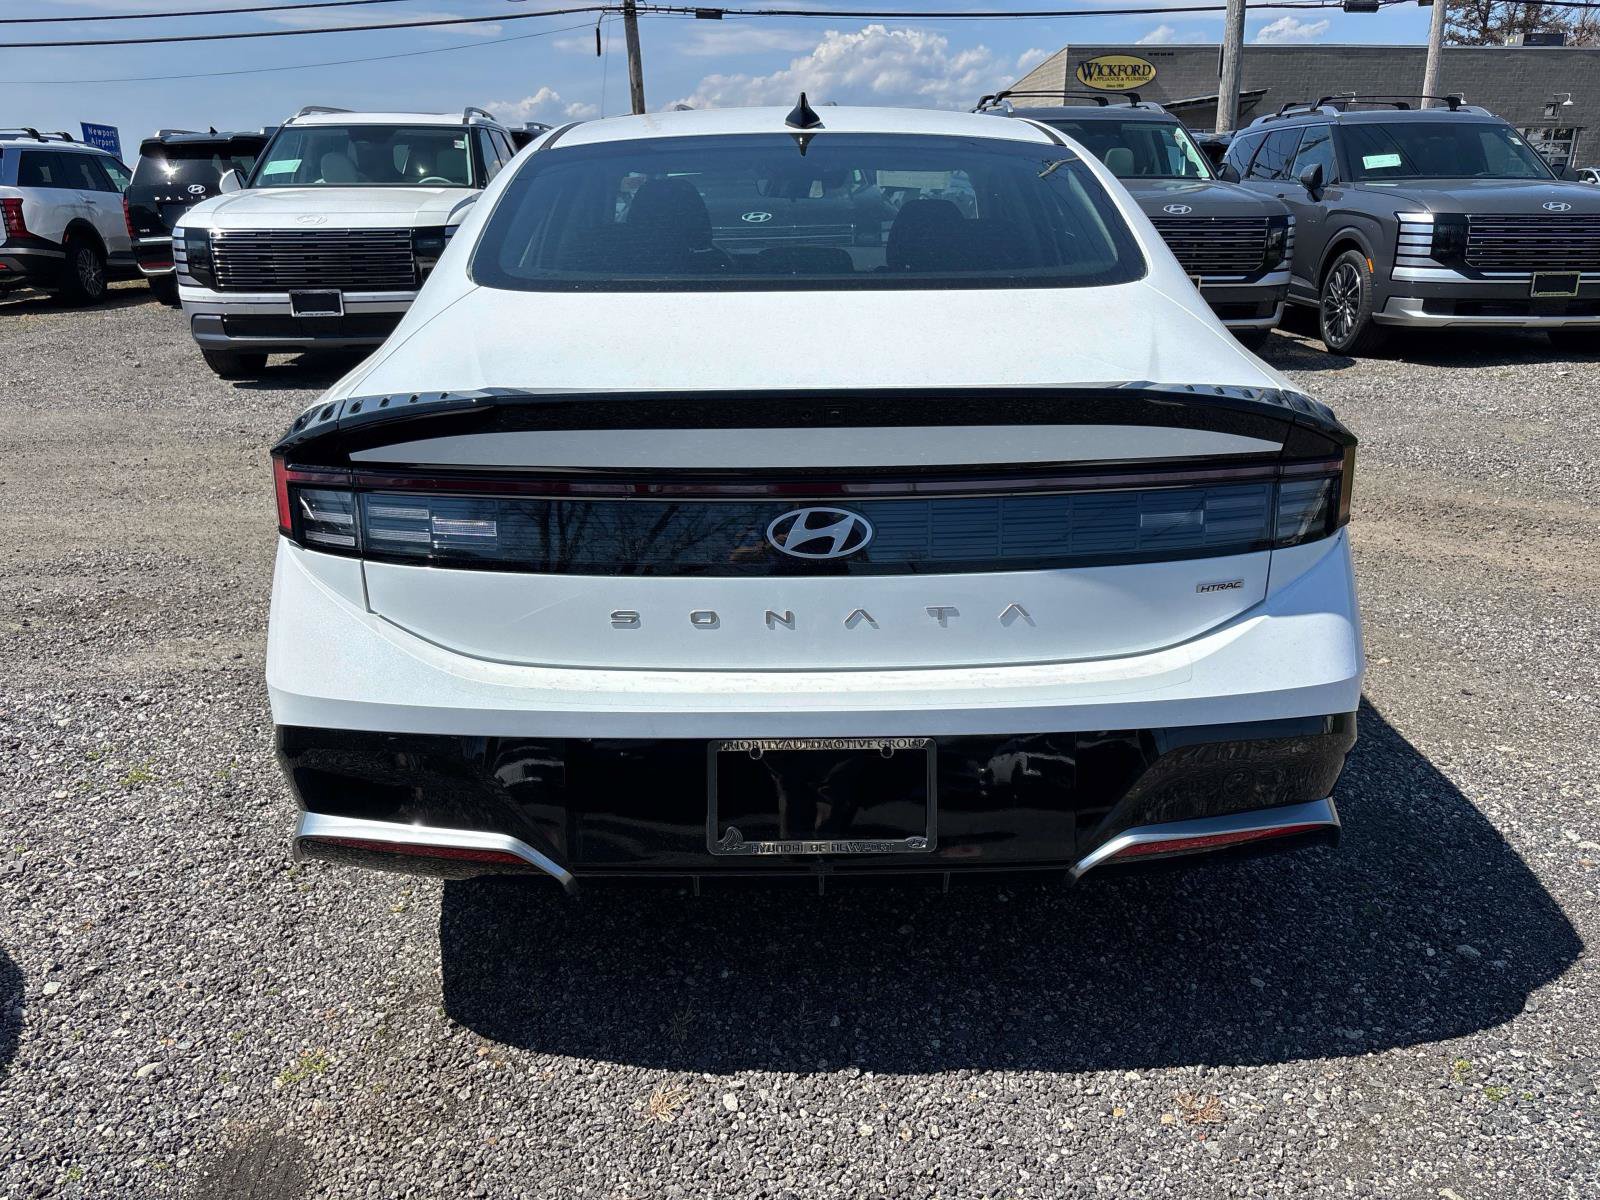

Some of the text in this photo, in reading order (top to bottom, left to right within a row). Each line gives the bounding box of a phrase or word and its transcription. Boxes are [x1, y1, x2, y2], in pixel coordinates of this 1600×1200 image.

[1079, 61, 1152, 81] WICKFORD
[87, 126, 116, 138] Newport
[91, 137, 115, 148] Airport
[1200, 581, 1243, 593] HTRAC
[610, 604, 1032, 627] SONATA
[720, 738, 926, 750] PRIORITY AUTOMOTIVE GROUP
[751, 842, 804, 853] HYUNDAI
[810, 842, 827, 853] OF
